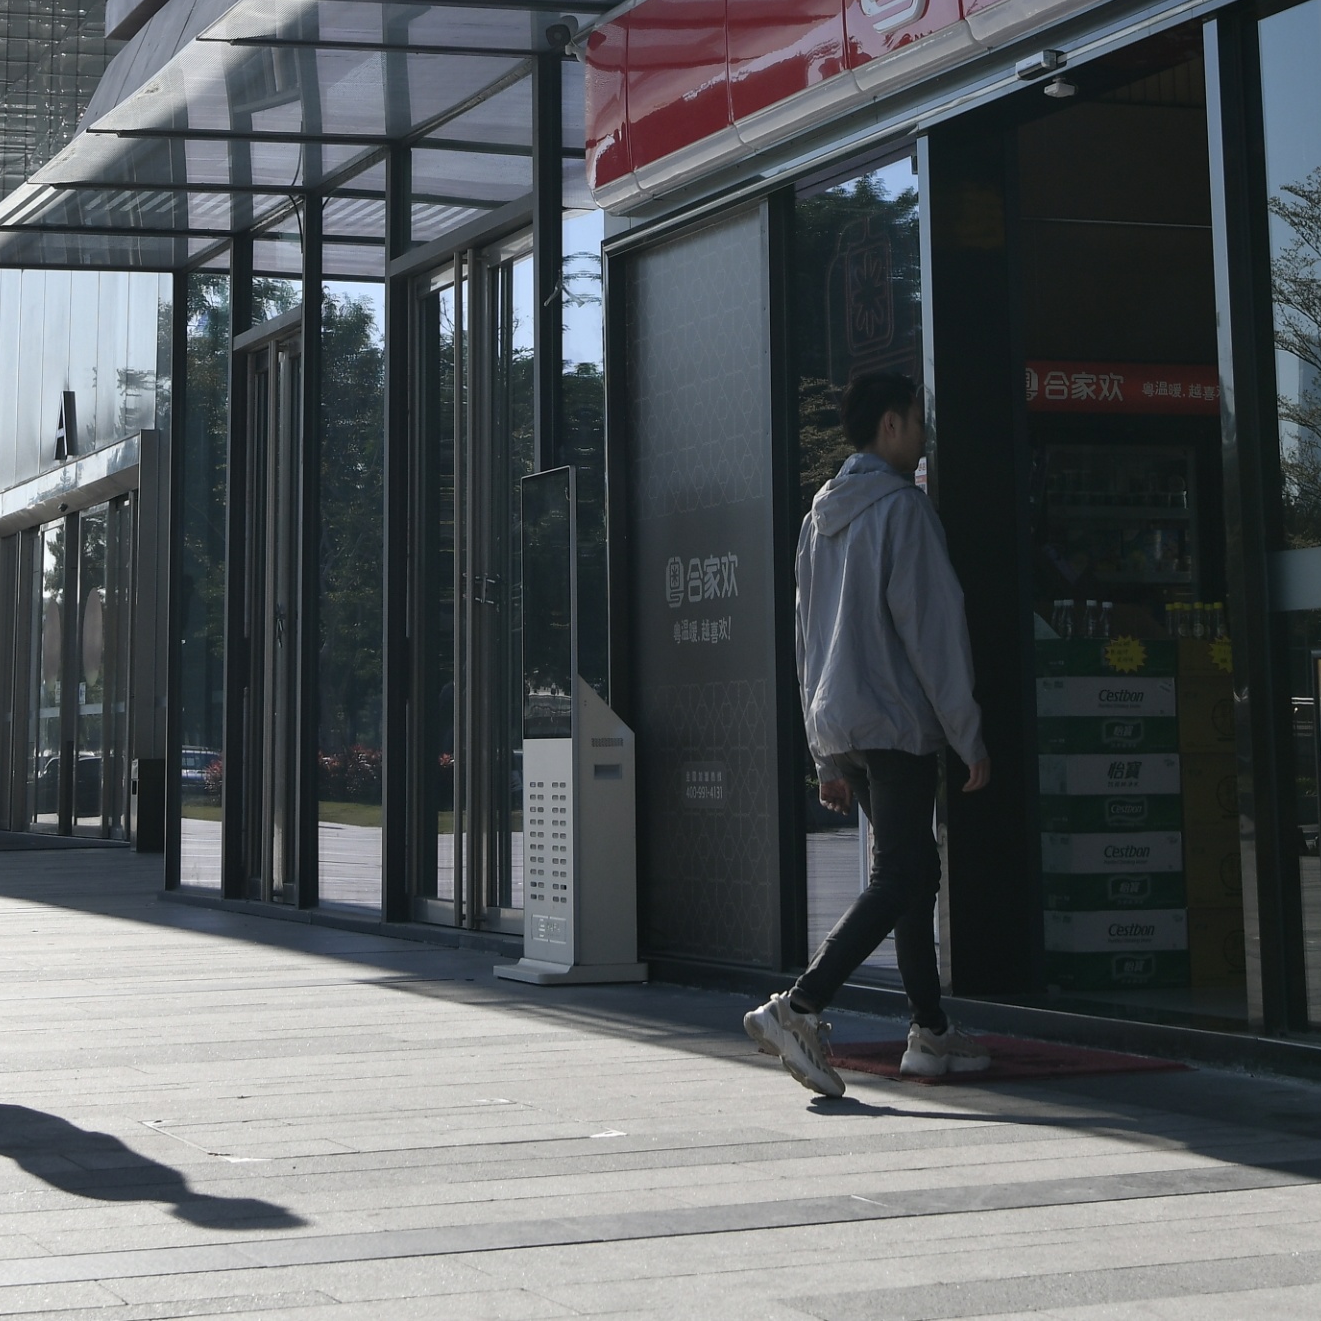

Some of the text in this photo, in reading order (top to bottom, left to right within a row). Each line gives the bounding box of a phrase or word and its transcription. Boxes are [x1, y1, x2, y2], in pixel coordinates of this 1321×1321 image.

[1044, 371, 1124, 402] 合家欢
[687, 551, 739, 603] 合家欢
